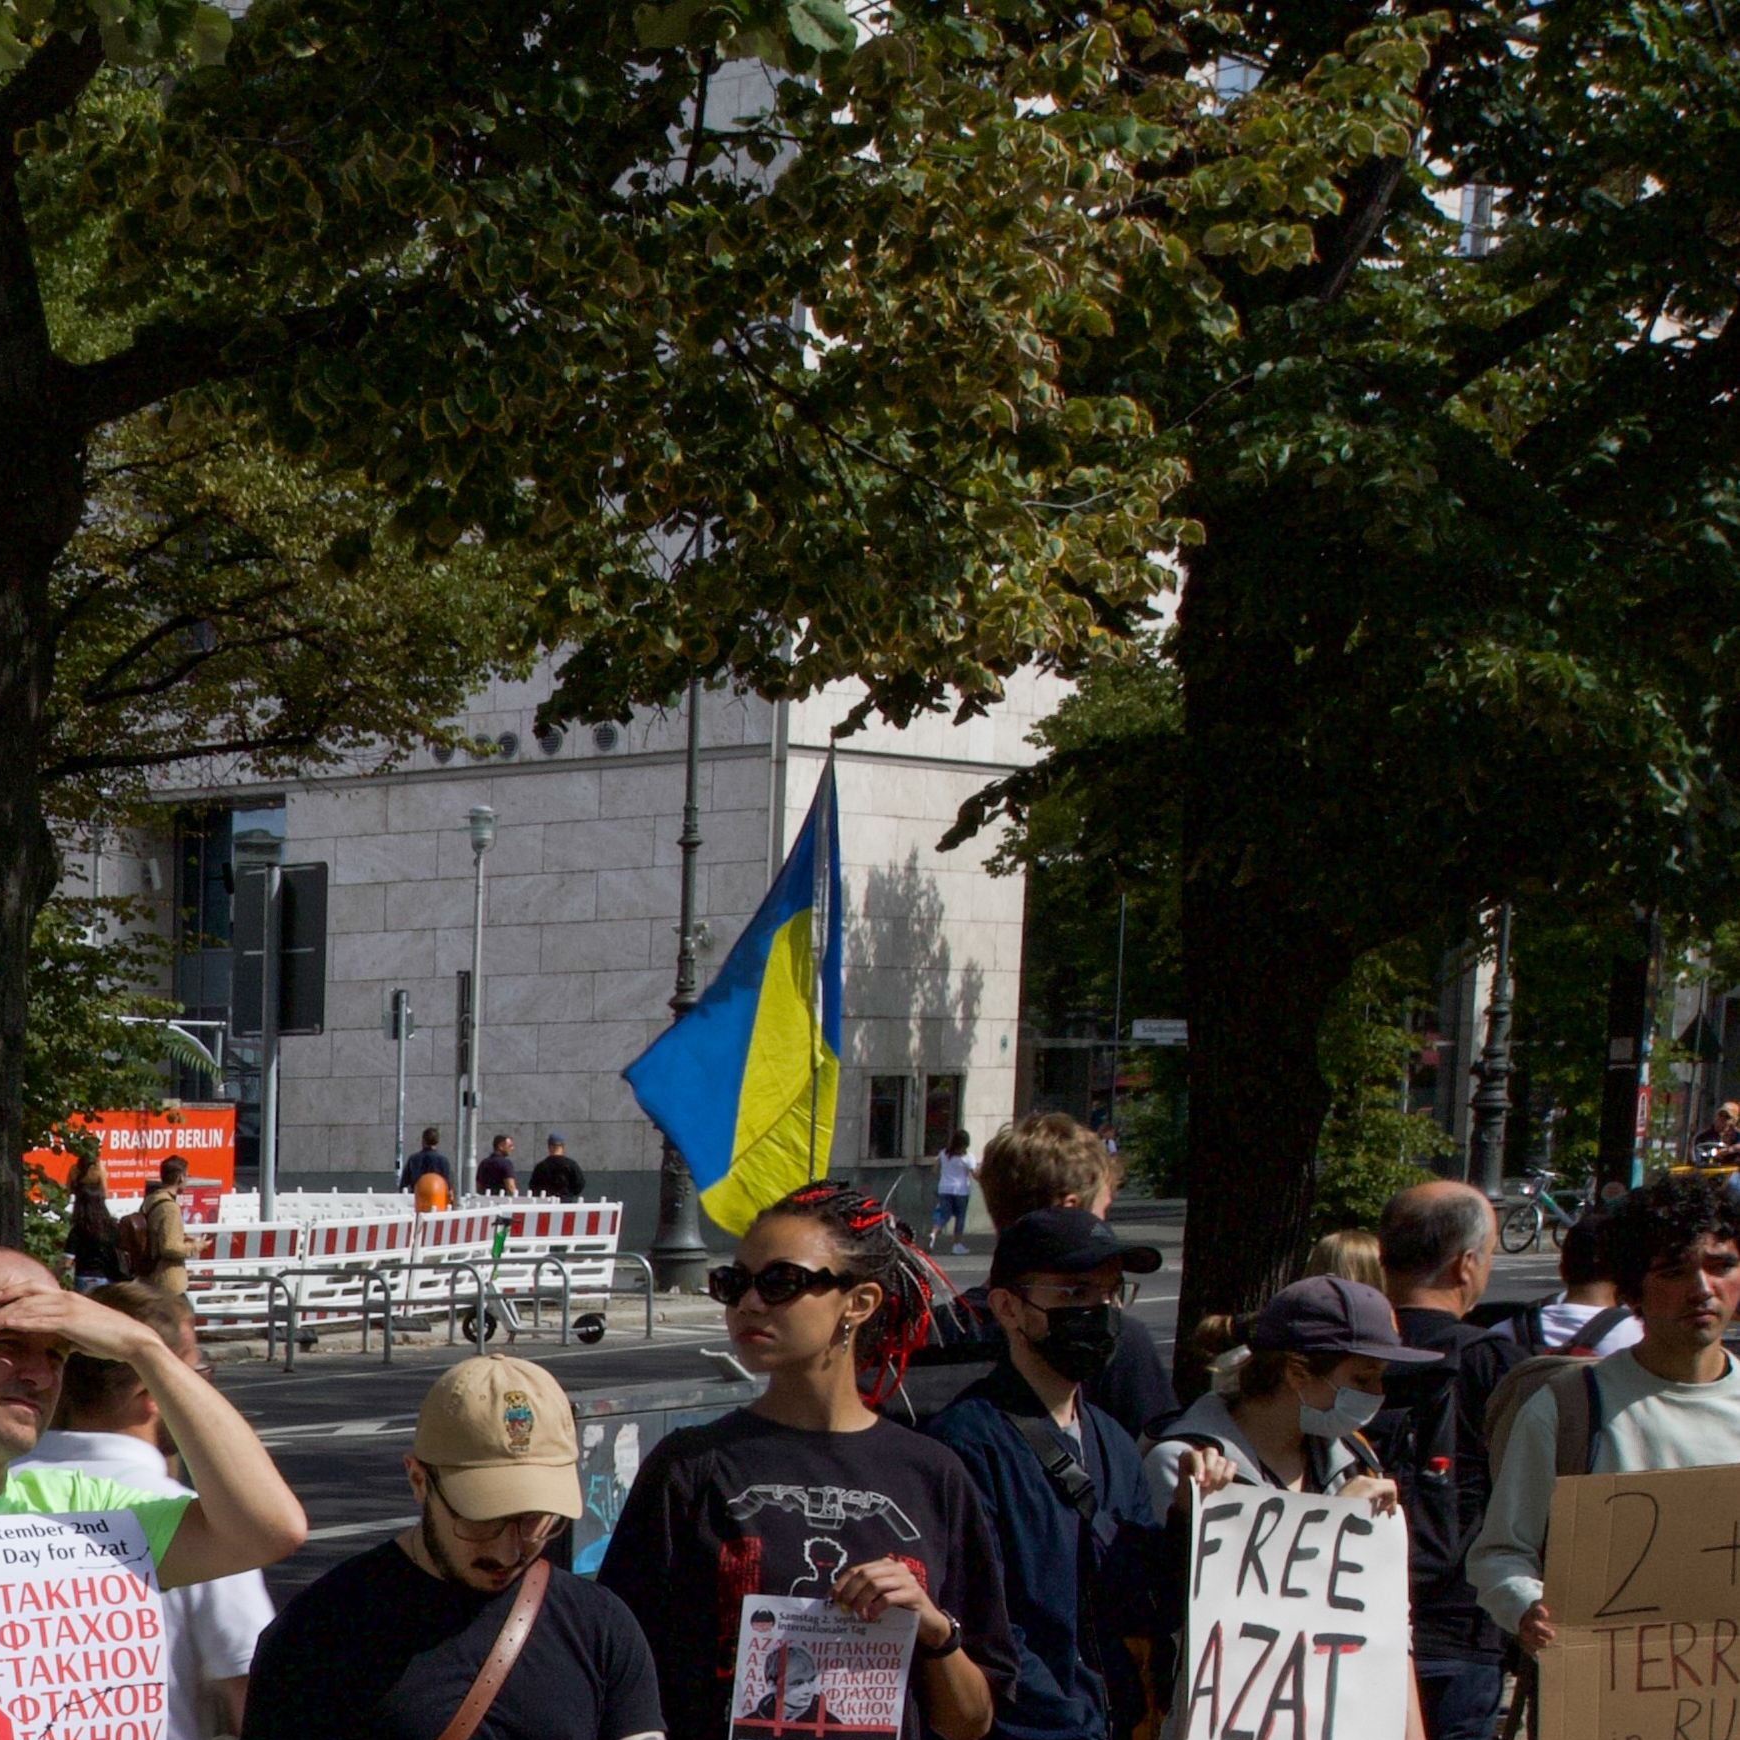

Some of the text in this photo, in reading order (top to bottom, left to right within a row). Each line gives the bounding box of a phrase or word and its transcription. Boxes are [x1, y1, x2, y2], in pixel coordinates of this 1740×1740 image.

[109, 1128, 174, 1150] BRANDT
[175, 1128, 223, 1149] BERLIN
[72, 1518, 110, 1536] 2nd
[3, 1547, 42, 1570] Day
[48, 1543, 77, 1562] for
[84, 1539, 130, 1559] Azat
[1193, 1496, 1375, 1612] FREE
[851, 1625, 867, 1635] Tag
